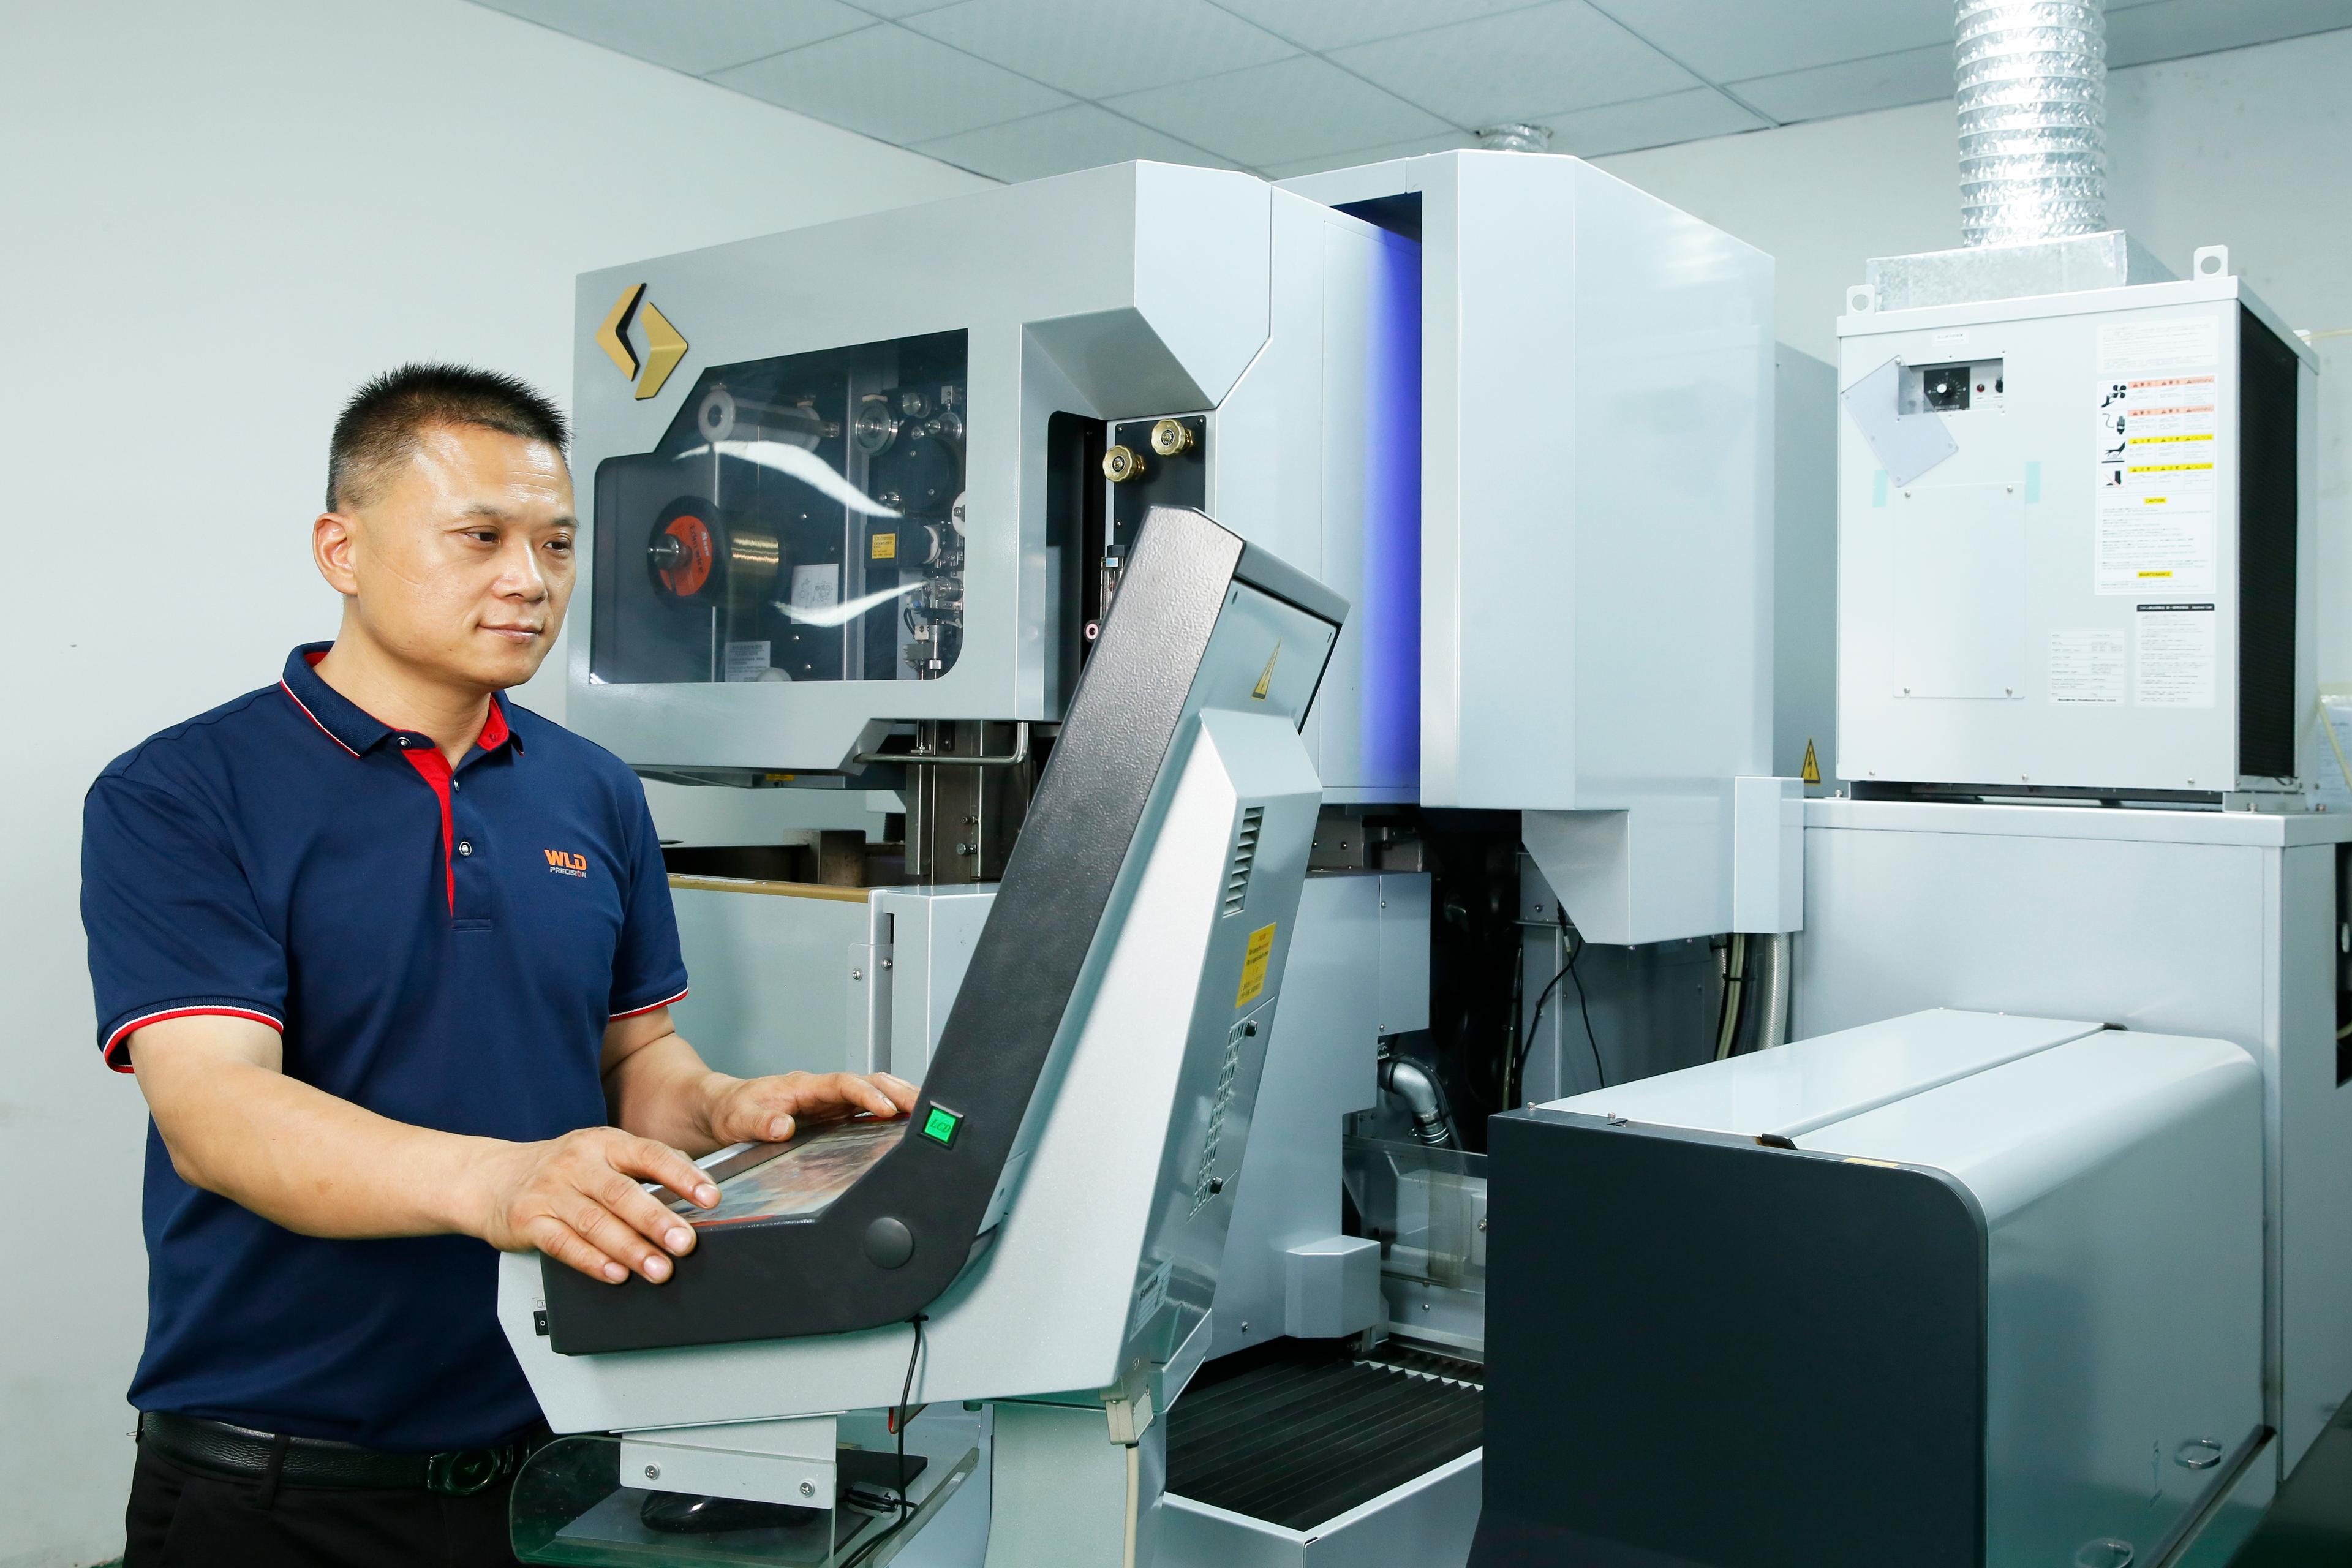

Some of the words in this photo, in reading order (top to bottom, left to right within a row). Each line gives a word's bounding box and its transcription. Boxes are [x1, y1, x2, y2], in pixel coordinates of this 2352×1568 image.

[544, 849, 587, 870] WLD
[549, 867, 587, 878] PRECISION
[930, 1119, 951, 1133] LCD
